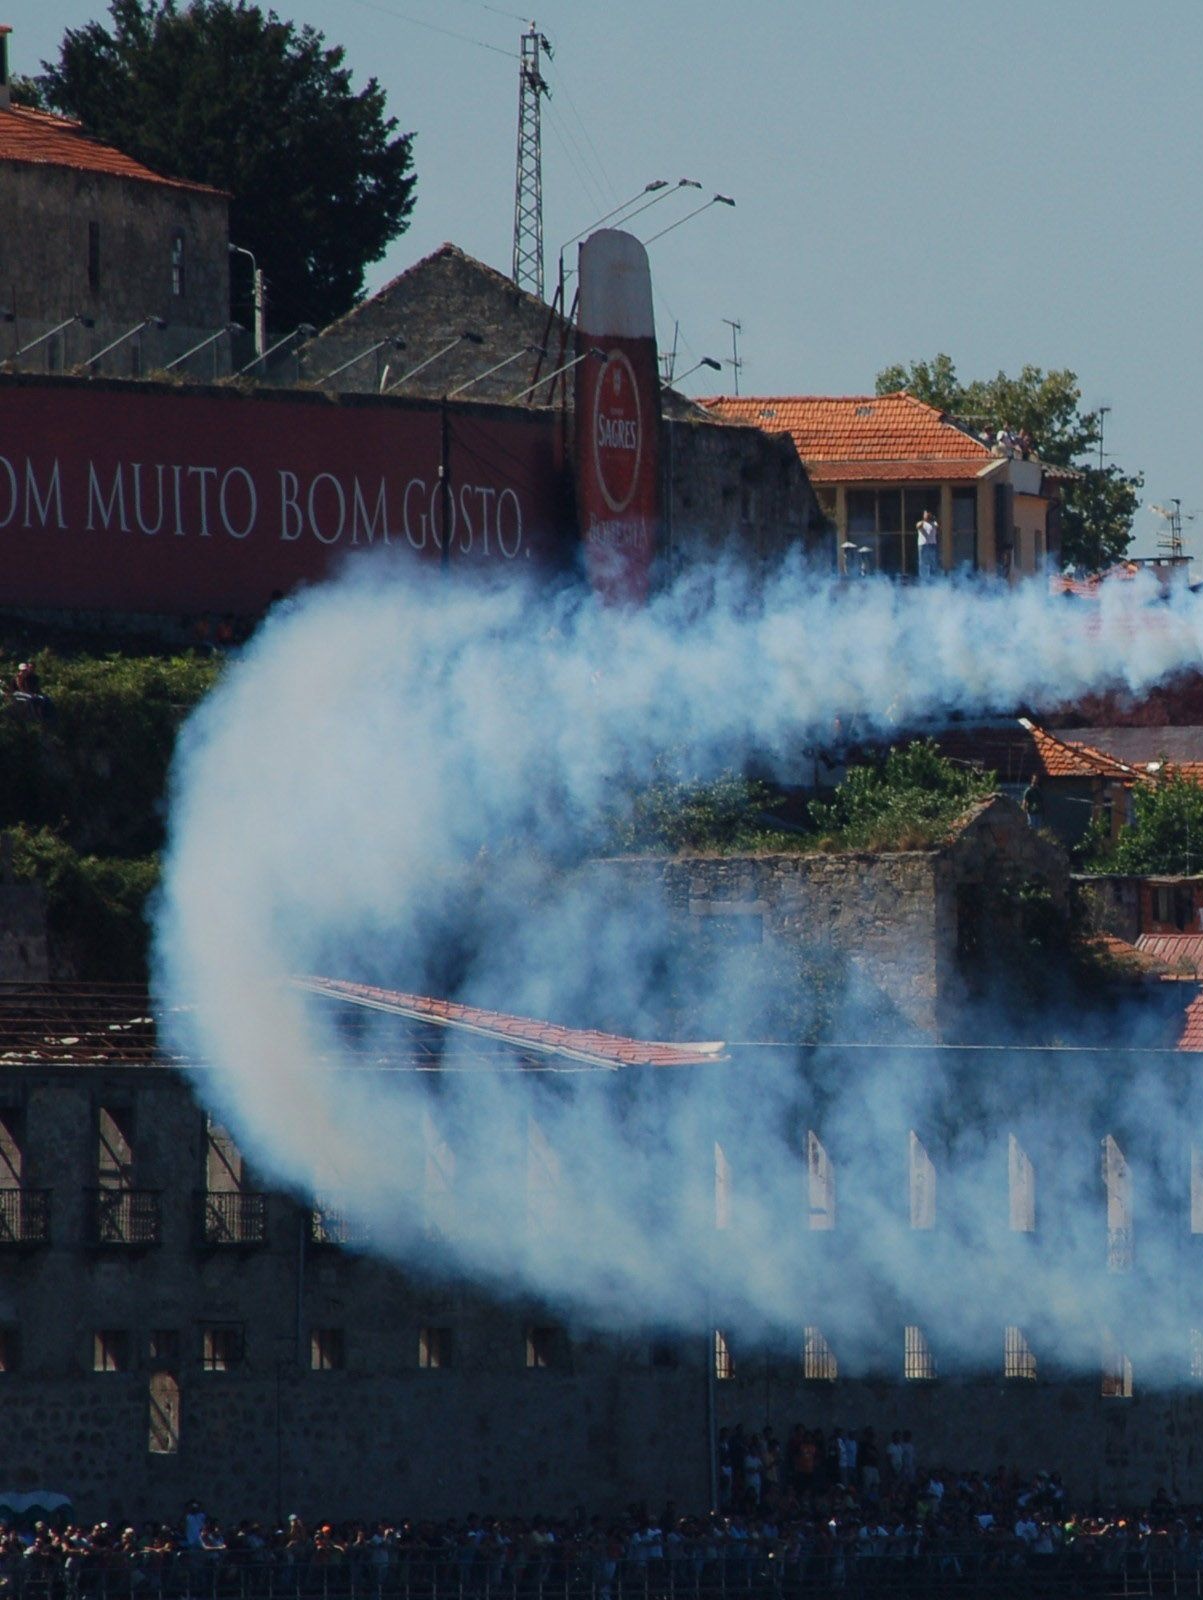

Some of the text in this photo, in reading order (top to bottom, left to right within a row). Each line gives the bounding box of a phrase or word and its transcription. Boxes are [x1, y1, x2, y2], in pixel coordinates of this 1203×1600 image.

[598, 413, 636, 449] SAGRES
[85, 459, 257, 539] MUITO
[278, 470, 391, 544] BOM
[403, 478, 530, 559] GOSTO.
